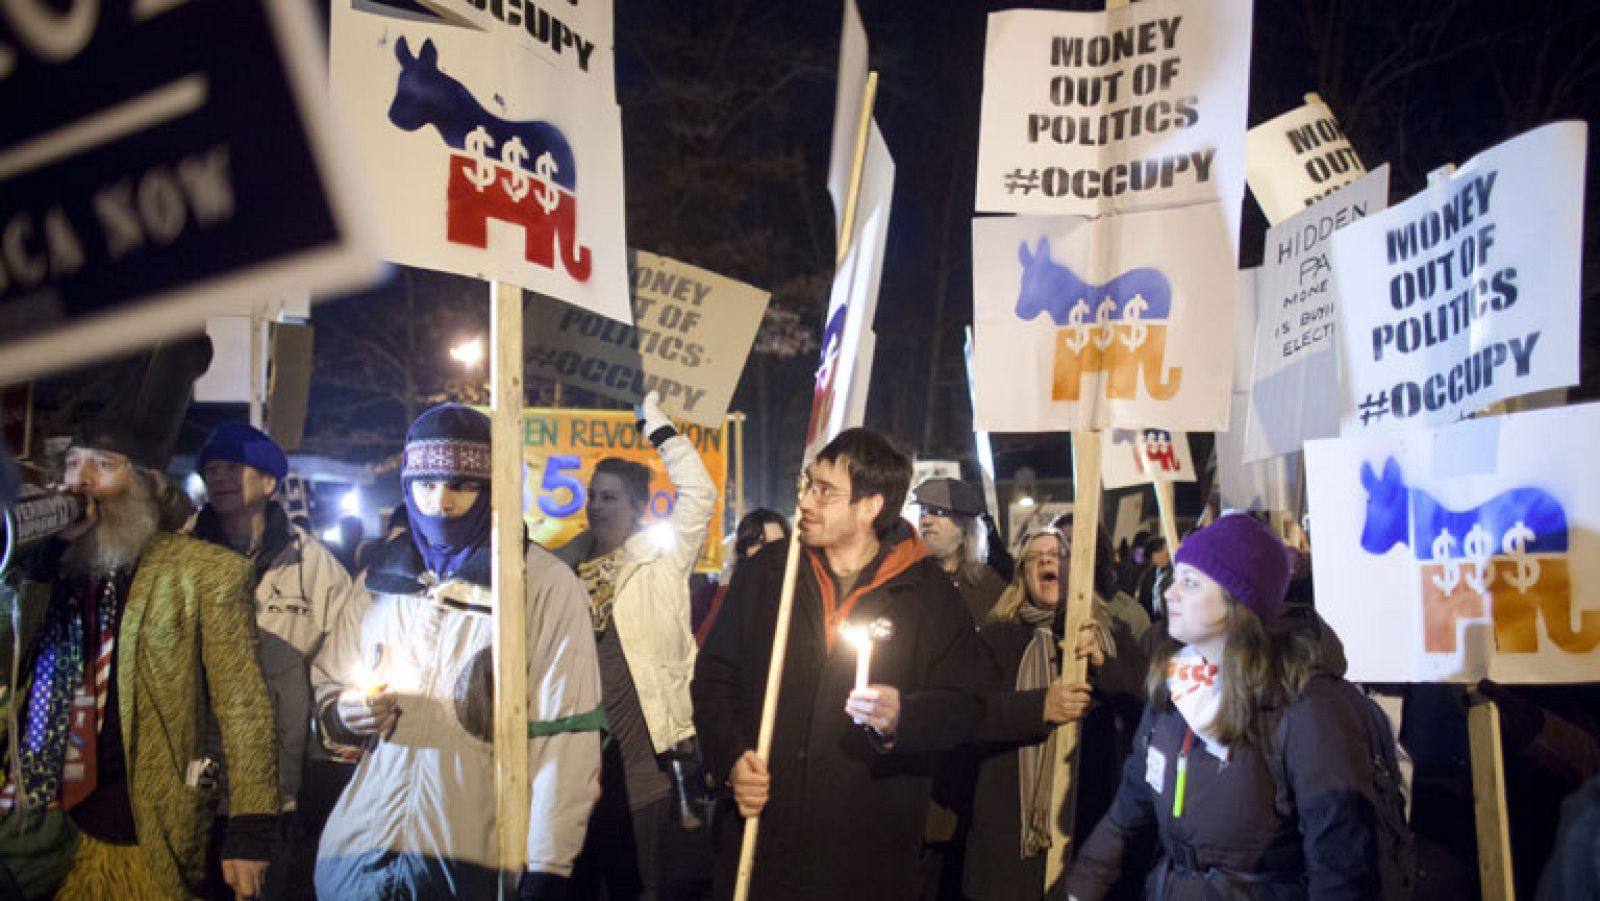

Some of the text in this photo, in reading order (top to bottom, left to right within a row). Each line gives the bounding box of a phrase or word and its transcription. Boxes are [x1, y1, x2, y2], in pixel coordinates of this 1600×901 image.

[1050, 16, 1182, 68] MONEY
[1050, 57, 1181, 107] OUT OF
[1026, 95, 1200, 146] POLITICS
[1286, 118, 1342, 154] MO
[1003, 147, 1217, 199] #OCCUPY
[1278, 200, 1367, 265] HIDDEN
[1386, 170, 1498, 265] MONEY
[633, 266, 712, 307] ONEY
[1299, 253, 1332, 286] PA
[1389, 222, 1497, 311] OUT OF
[657, 303, 701, 333] OF
[1283, 279, 1329, 309] MONE
[1372, 267, 1519, 362] POLITICS
[558, 308, 704, 368] POLITICS
[1283, 322, 1336, 358] ELECTI
[1358, 330, 1542, 426] #OCCUPY
[523, 416, 557, 447] EN
